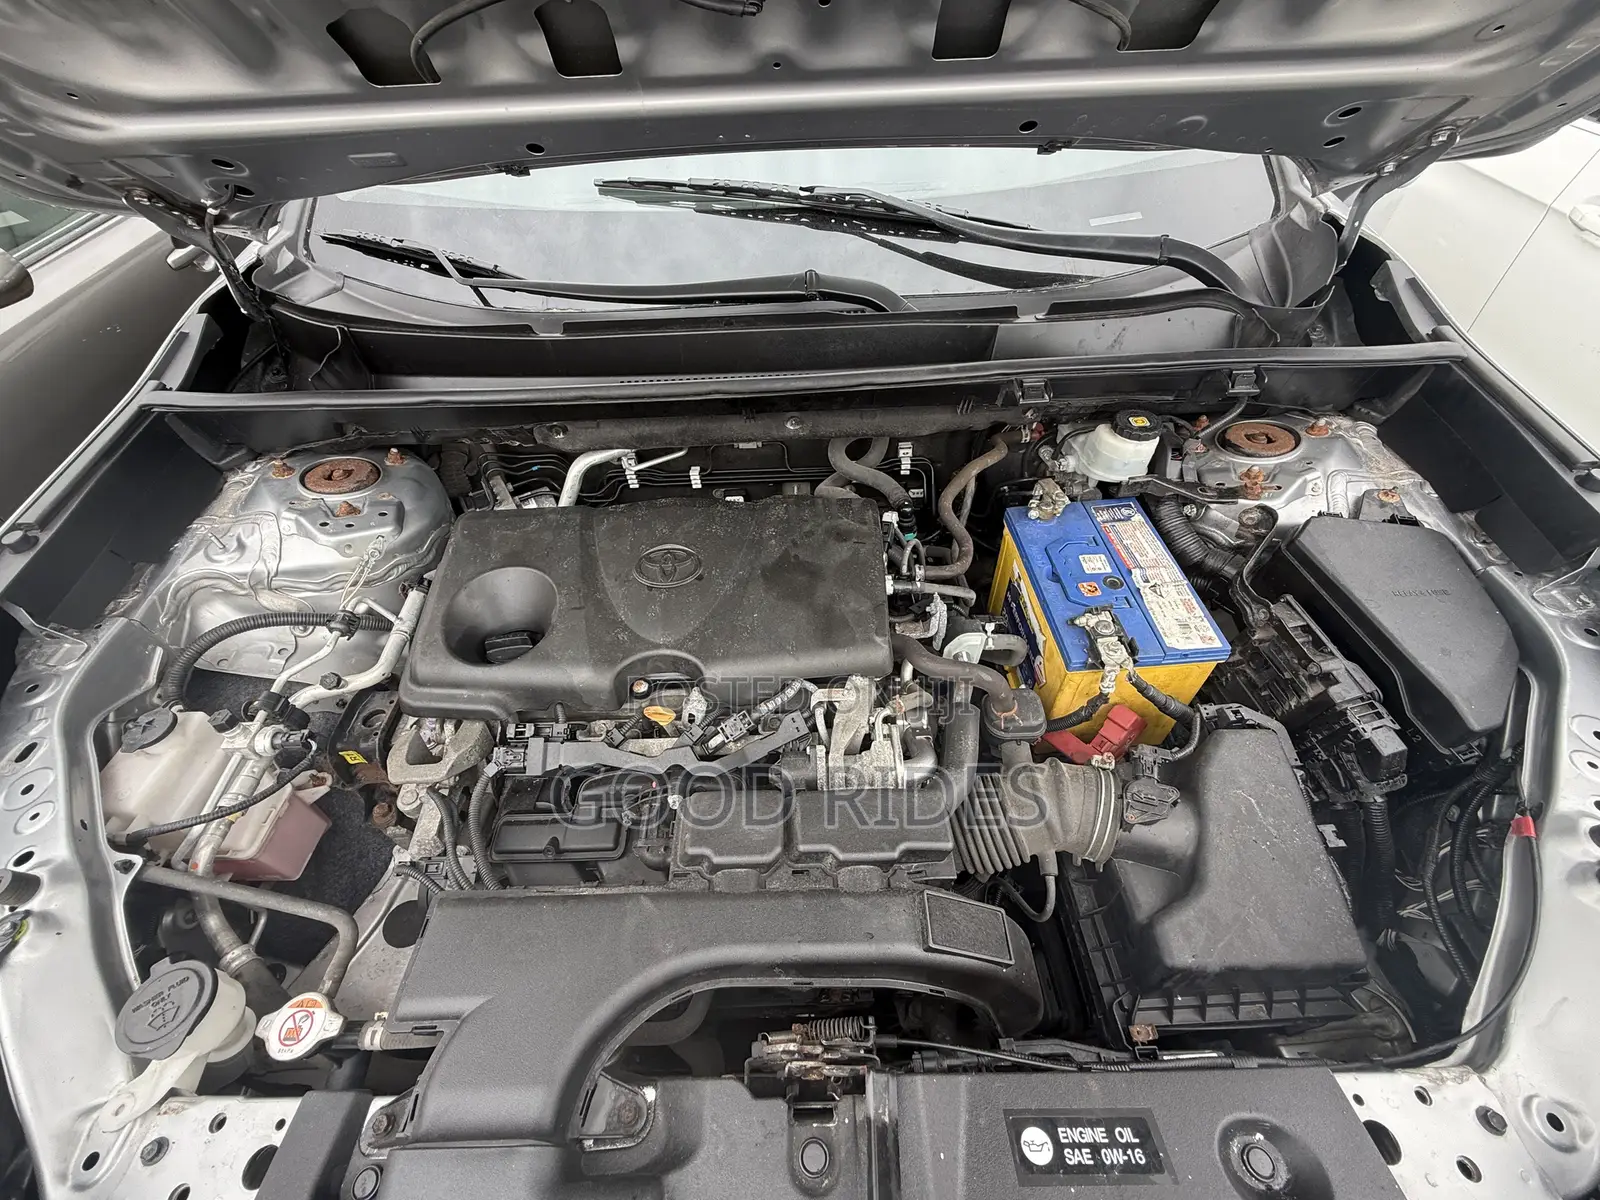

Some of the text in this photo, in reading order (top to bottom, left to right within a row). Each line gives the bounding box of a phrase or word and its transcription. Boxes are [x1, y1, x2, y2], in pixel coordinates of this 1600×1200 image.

[132, 976, 189, 1013] WASHER FLUID
[151, 993, 171, 1007] ONLY
[1057, 1127, 1140, 1143] ENGINE OIL
[1063, 1148, 1146, 1165] SAE 0W-16
